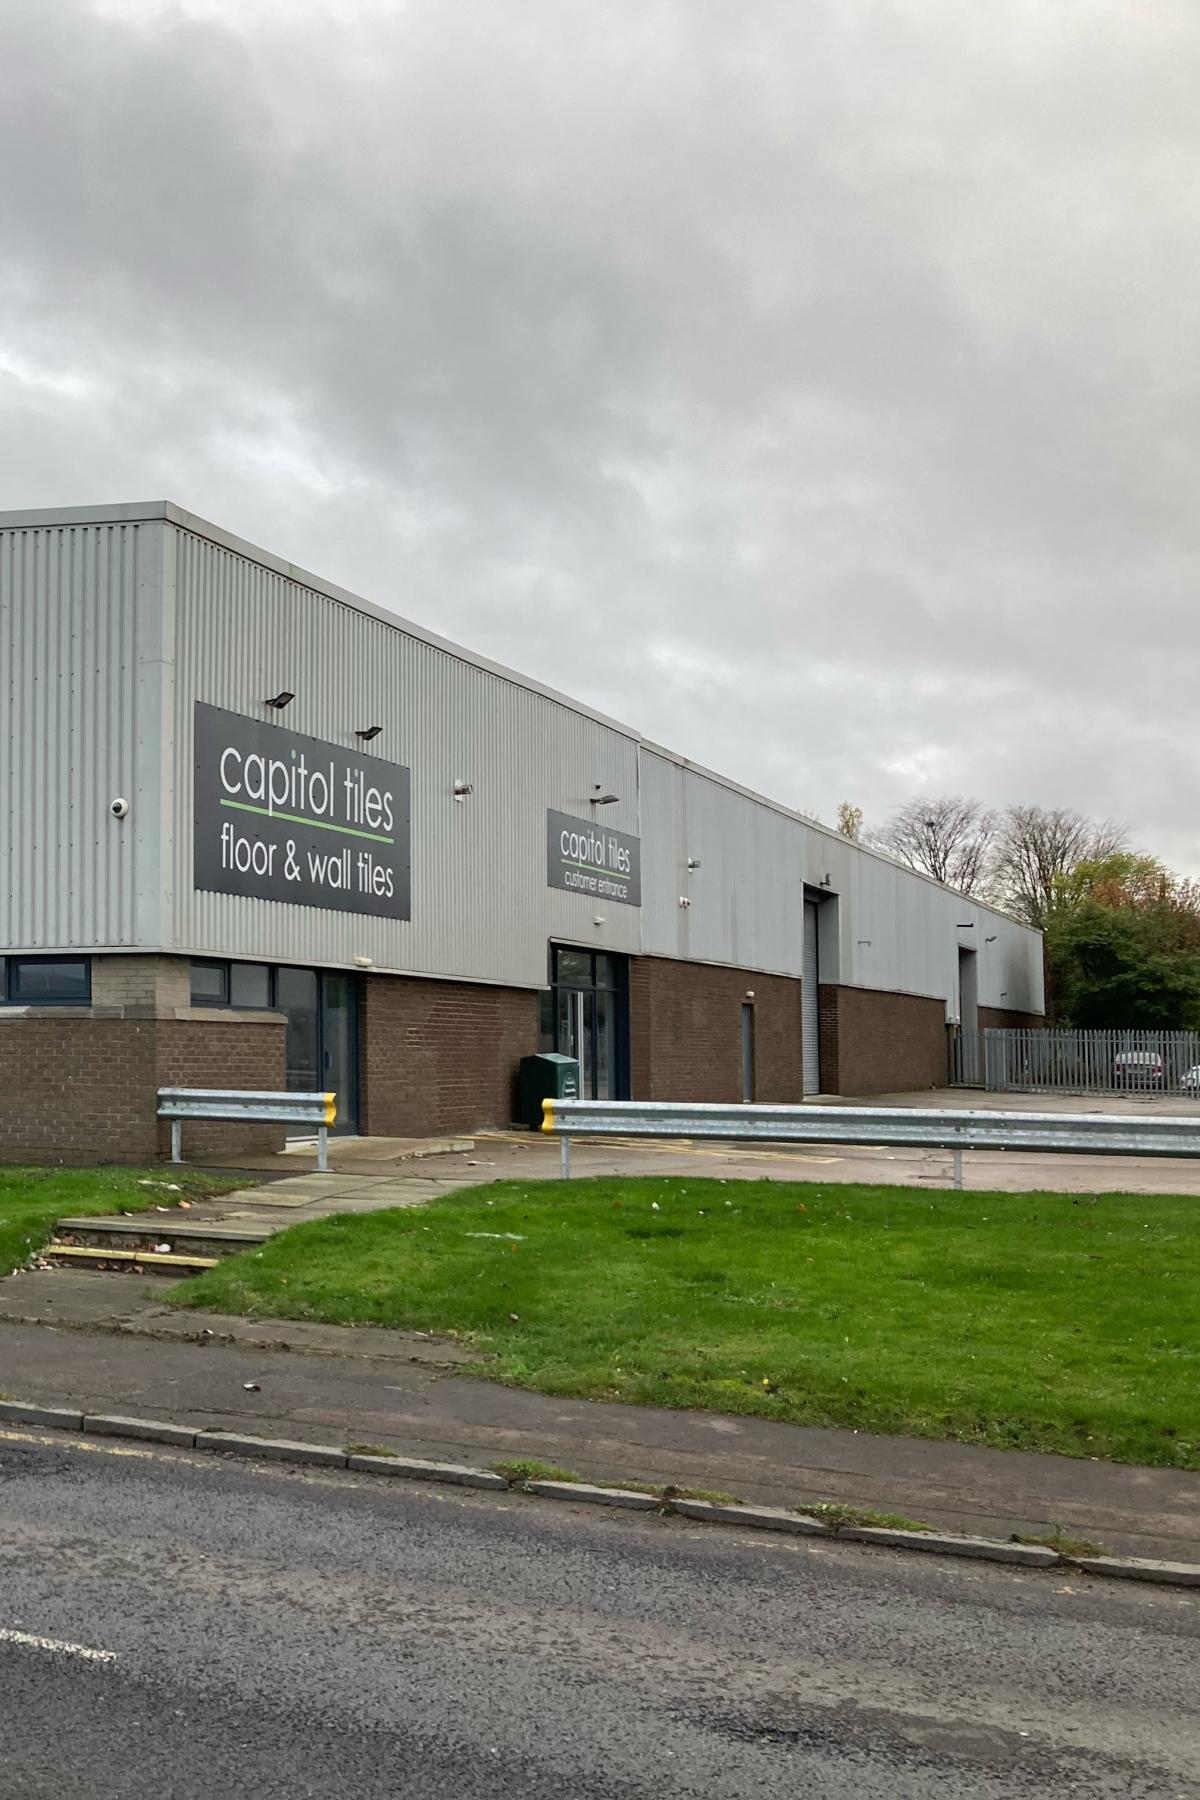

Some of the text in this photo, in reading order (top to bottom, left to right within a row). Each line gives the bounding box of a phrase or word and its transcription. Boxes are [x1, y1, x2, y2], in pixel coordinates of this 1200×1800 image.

[220, 747, 394, 832] capitol tiles
[221, 822, 394, 898] floor & wall tiles
[560, 829, 630, 873] capitol tiles
[565, 870, 628, 898] customer entrance
